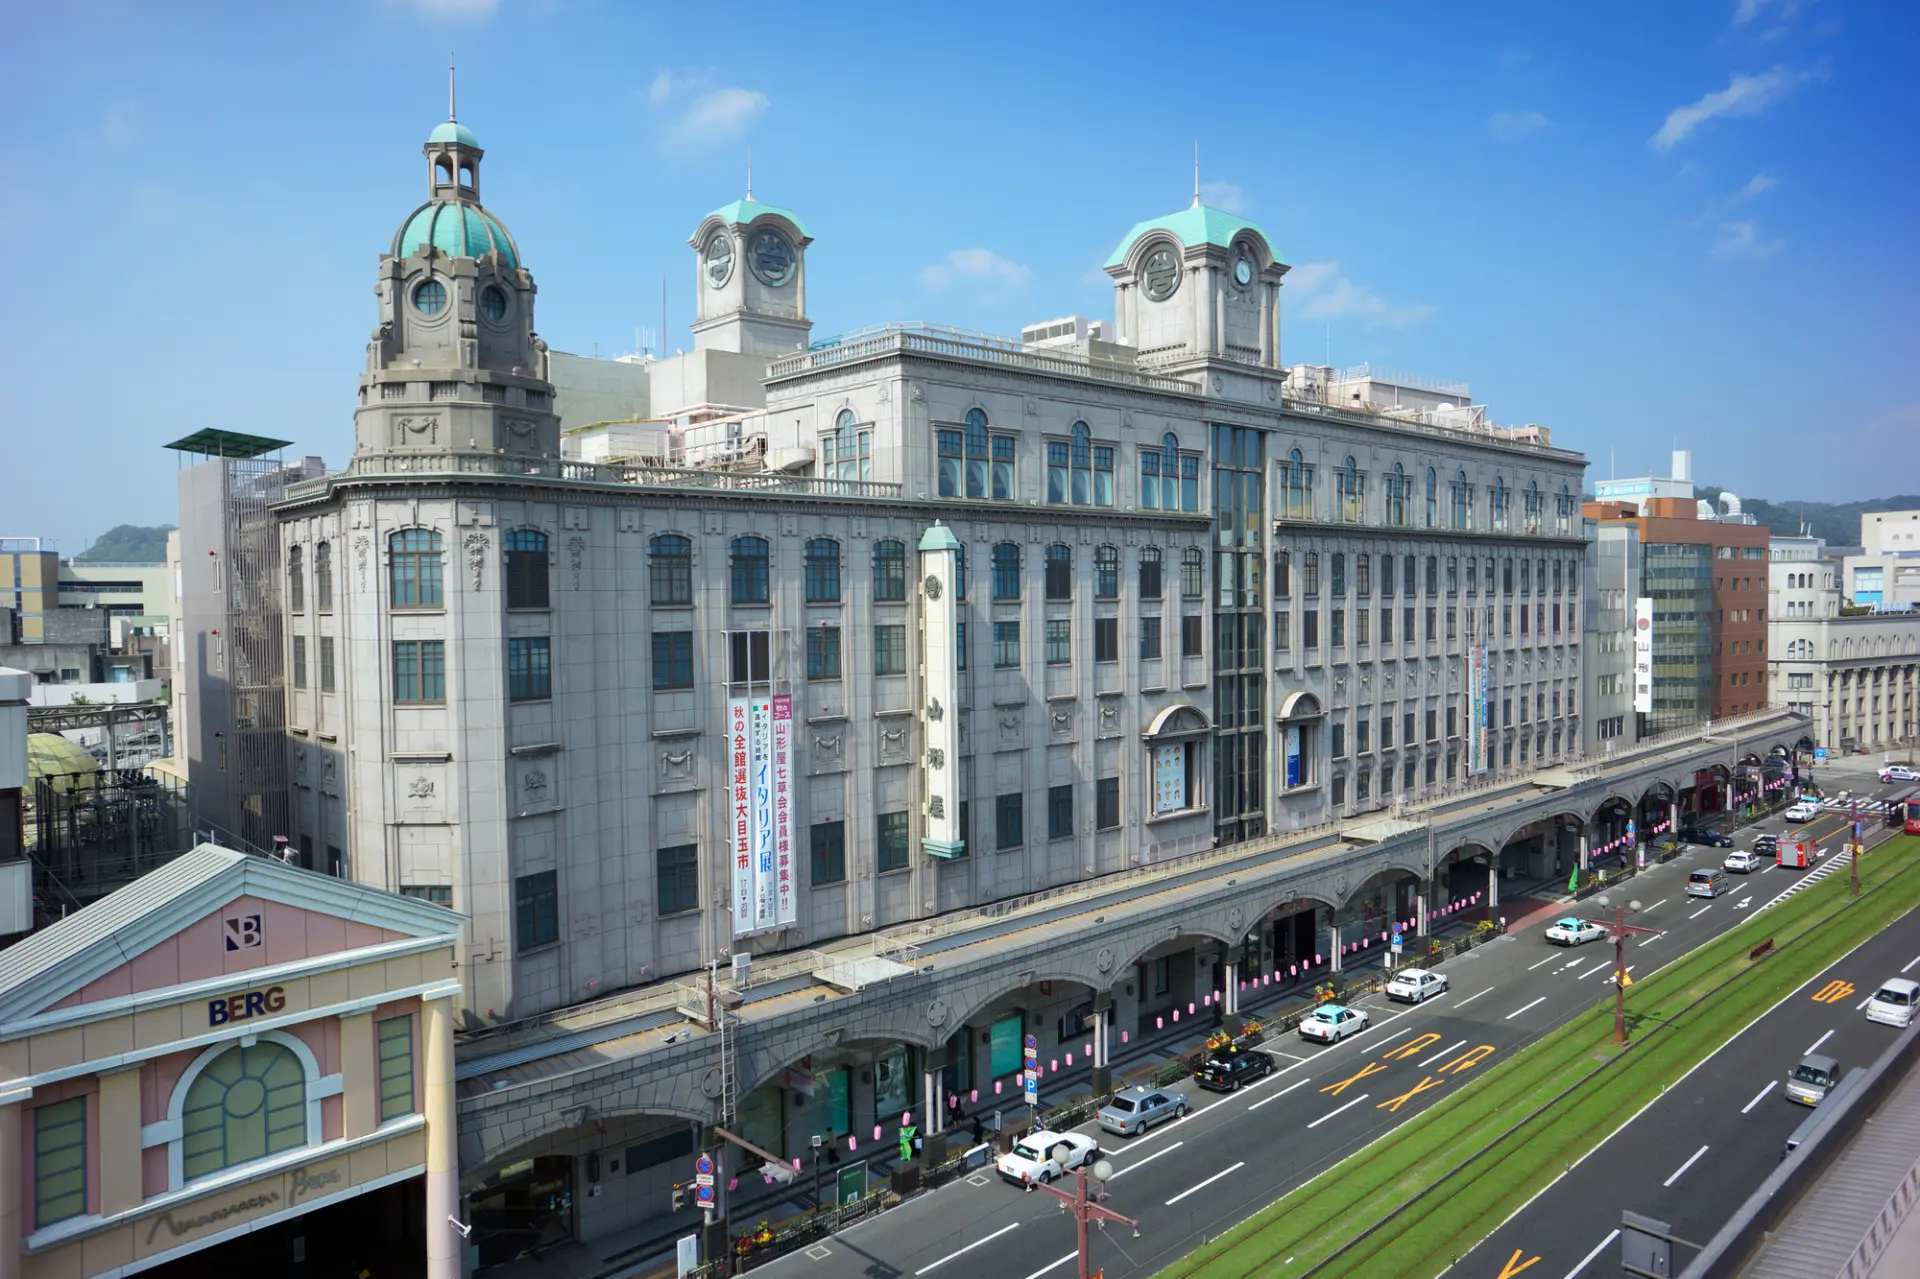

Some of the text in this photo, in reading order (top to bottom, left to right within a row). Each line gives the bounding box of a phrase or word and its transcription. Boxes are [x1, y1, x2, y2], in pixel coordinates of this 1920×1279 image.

[733, 705, 749, 870] 秋の全館選抜大目玉市
[761, 713, 769, 761] イタリアを
[927, 696, 944, 820] 山形屋
[757, 763, 773, 873] イタリア展
[208, 986, 287, 1028] BERG
